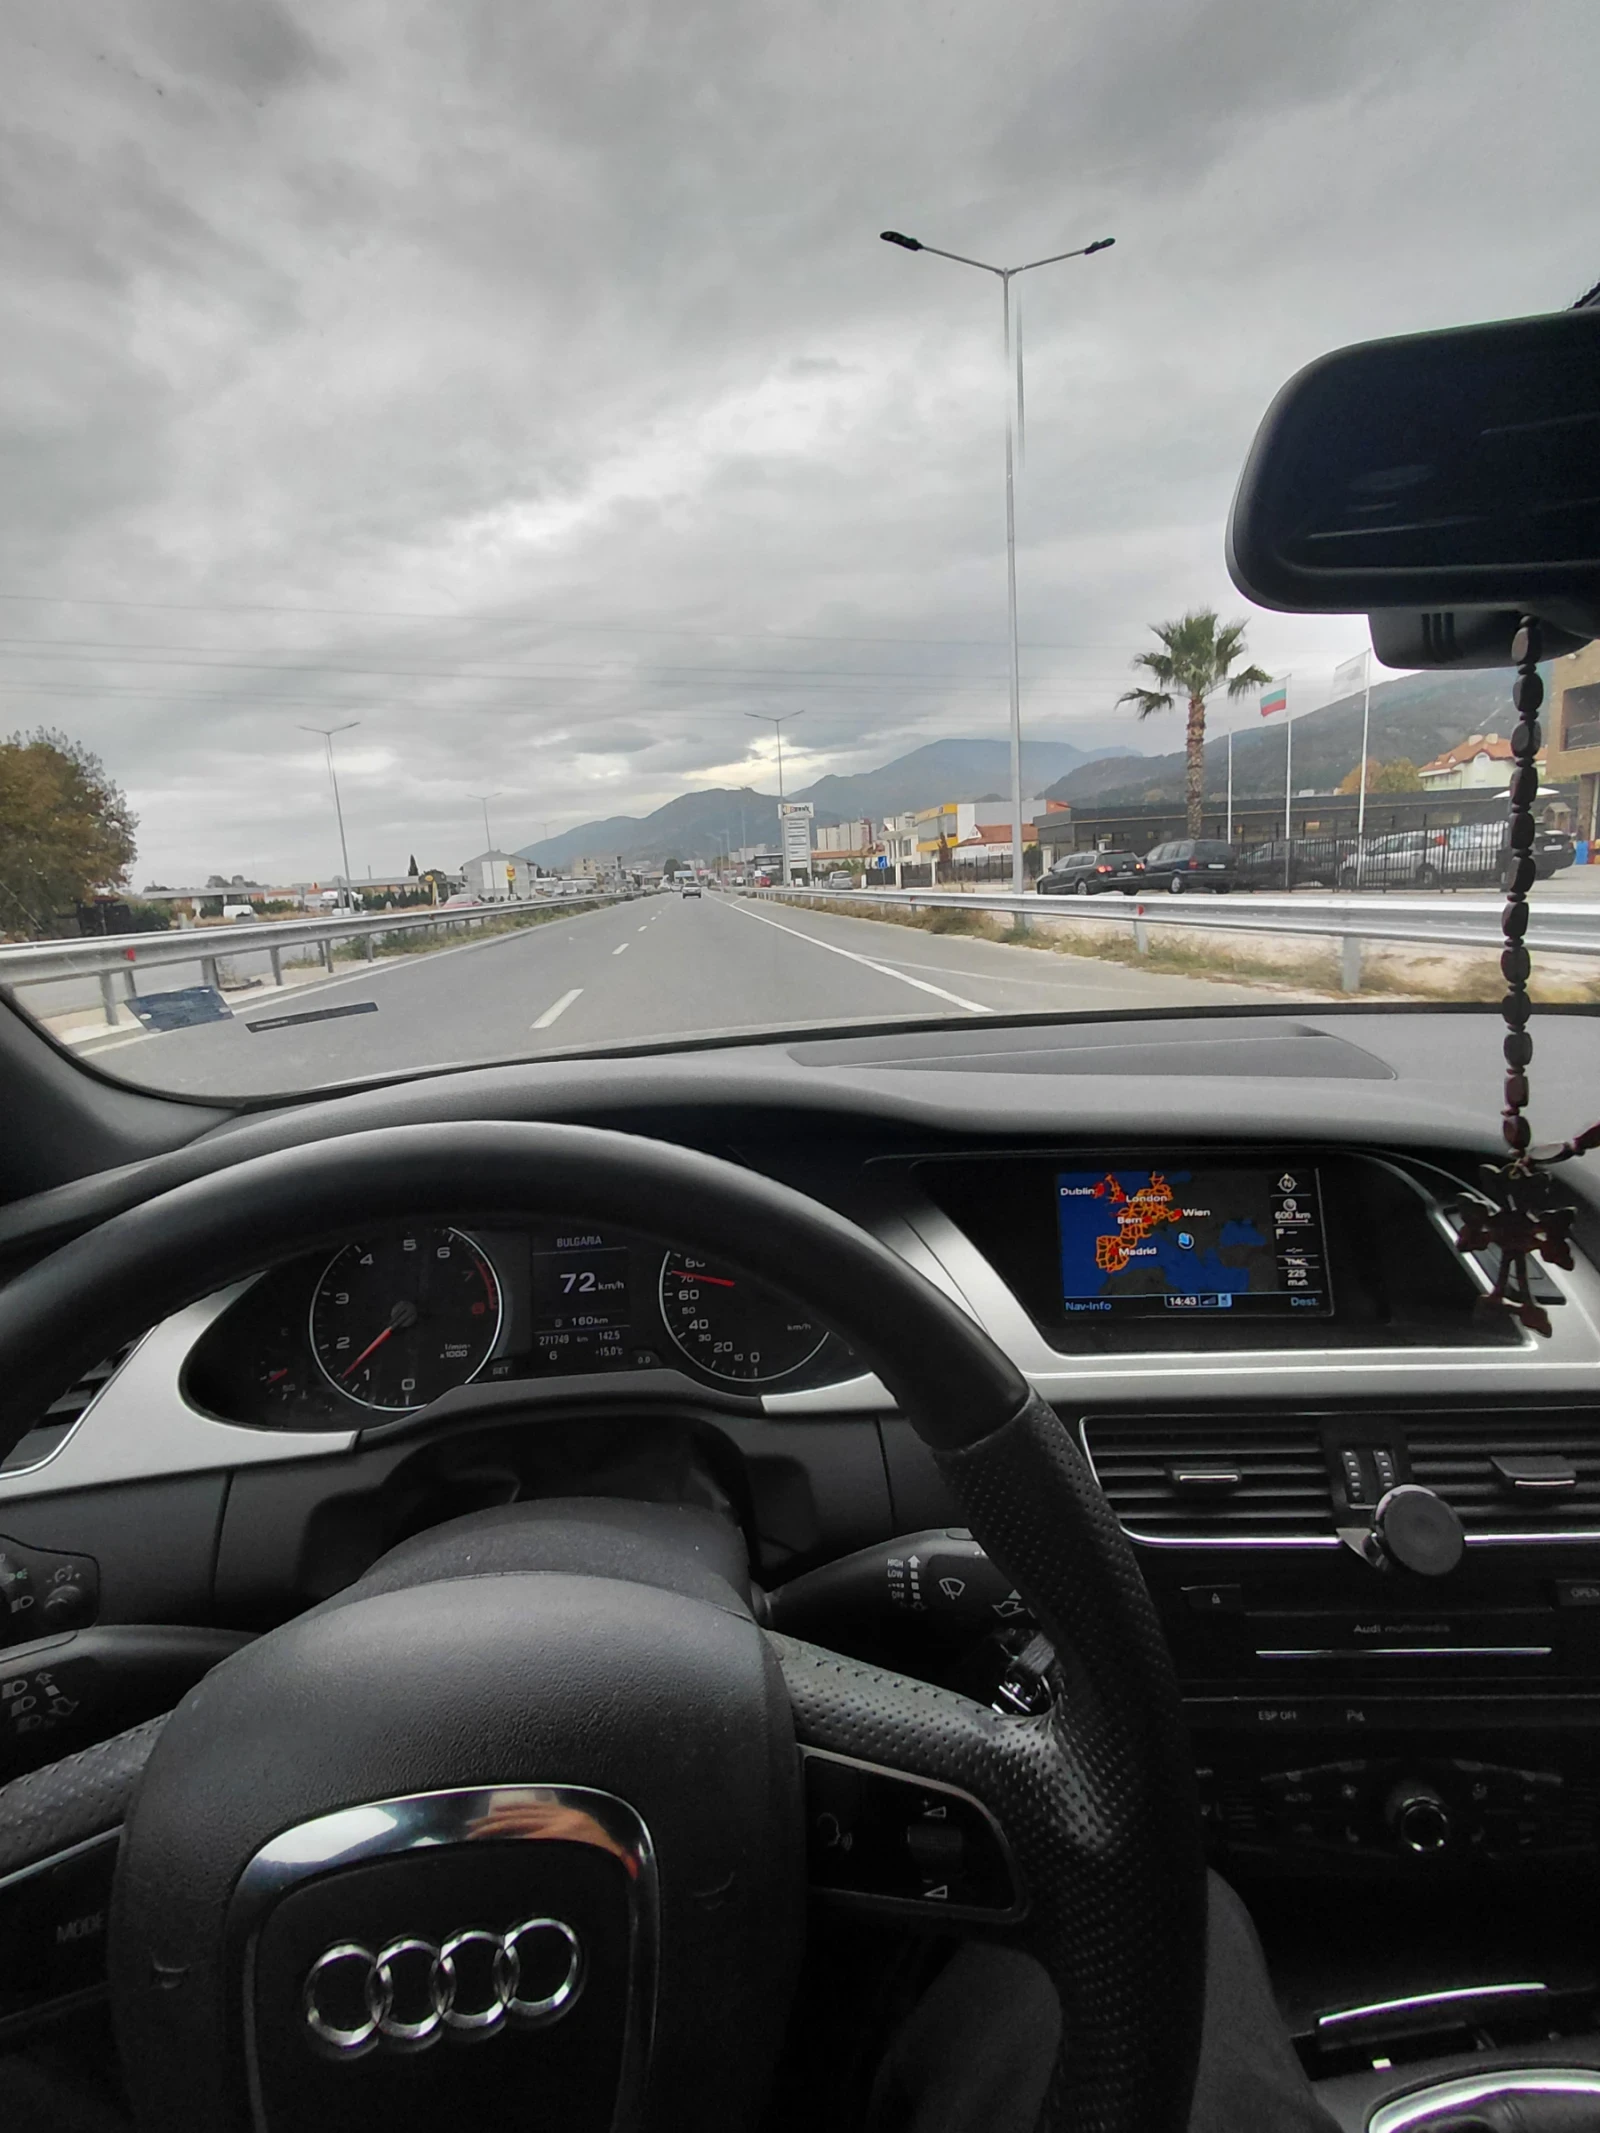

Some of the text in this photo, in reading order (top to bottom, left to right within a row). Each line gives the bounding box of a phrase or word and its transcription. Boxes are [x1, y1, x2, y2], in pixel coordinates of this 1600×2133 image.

[1060, 1186, 1095, 1196] Dublin
[1126, 1193, 1168, 1202] London
[1182, 1208, 1210, 1217] Wien
[1275, 1211, 1311, 1220] 600 km
[1117, 1216, 1142, 1225] Bern
[403, 1238, 417, 1251] 5
[556, 1235, 603, 1248] BULGARIA
[437, 1246, 450, 1259] 6
[1119, 1246, 1157, 1256] Madrid
[359, 1253, 374, 1266] 4
[560, 1271, 625, 1293] 72 km/h
[335, 1292, 350, 1305] 3
[678, 1289, 700, 1300] 60
[1169, 1296, 1197, 1306] 14:43
[681, 1306, 696, 1315] 50
[688, 1318, 709, 1330] 40
[336, 1336, 350, 1350] 2
[698, 1333, 712, 1342] 30
[713, 1341, 733, 1353] 20
[749, 1352, 761, 1363] 0
[363, 1368, 371, 1381] 1
[401, 1378, 416, 1391] 0
[887, 1569, 904, 1579] LOW
[1353, 1624, 1381, 1634] Audi
